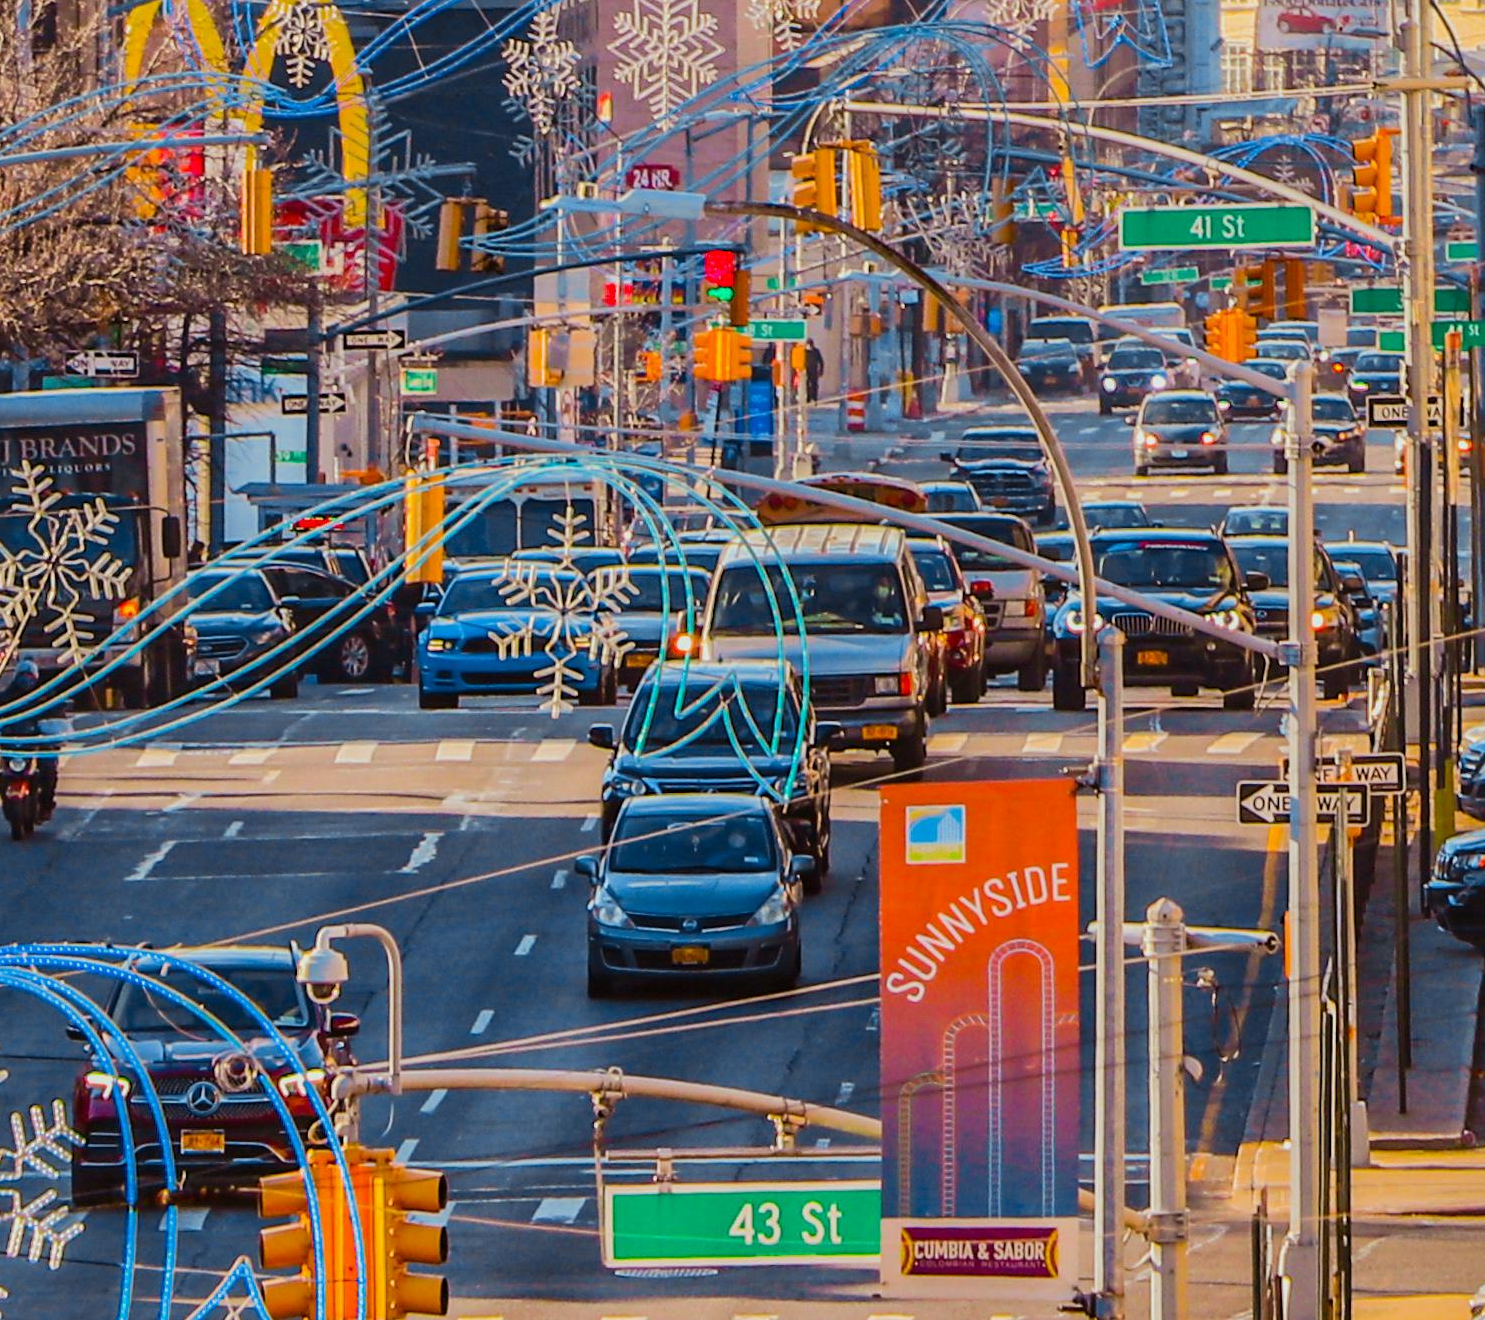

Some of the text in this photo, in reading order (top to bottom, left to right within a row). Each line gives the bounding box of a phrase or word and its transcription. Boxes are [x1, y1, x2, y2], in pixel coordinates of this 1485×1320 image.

[1189, 213, 1246, 240] 41 St
[1381, 407, 1409, 419] ONE
[19, 433, 137, 460] BRANDS
[49, 462, 111, 475] LIQUORS
[1355, 766, 1393, 781] WAY
[1253, 795, 1291, 811] ONE
[886, 862, 1072, 1004] SUNNYSIDE
[728, 1200, 843, 1246] 43 St
[914, 1240, 1045, 1261] CUMBIA & SABOR
